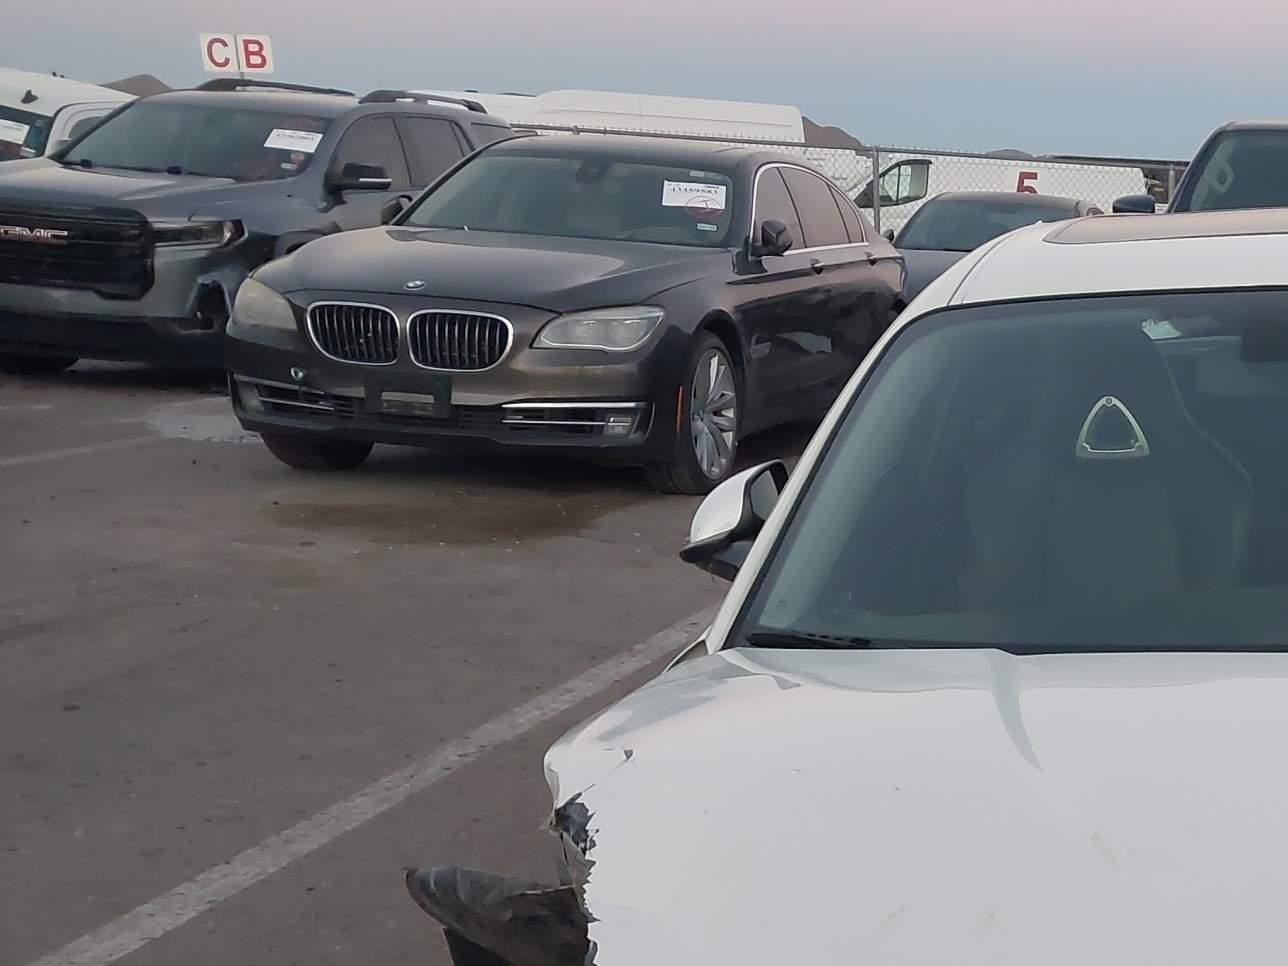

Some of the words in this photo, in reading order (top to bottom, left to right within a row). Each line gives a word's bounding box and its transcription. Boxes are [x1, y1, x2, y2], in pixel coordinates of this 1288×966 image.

[207, 37, 231, 68] C
[243, 38, 267, 69] B
[1016, 171, 1039, 193] 5
